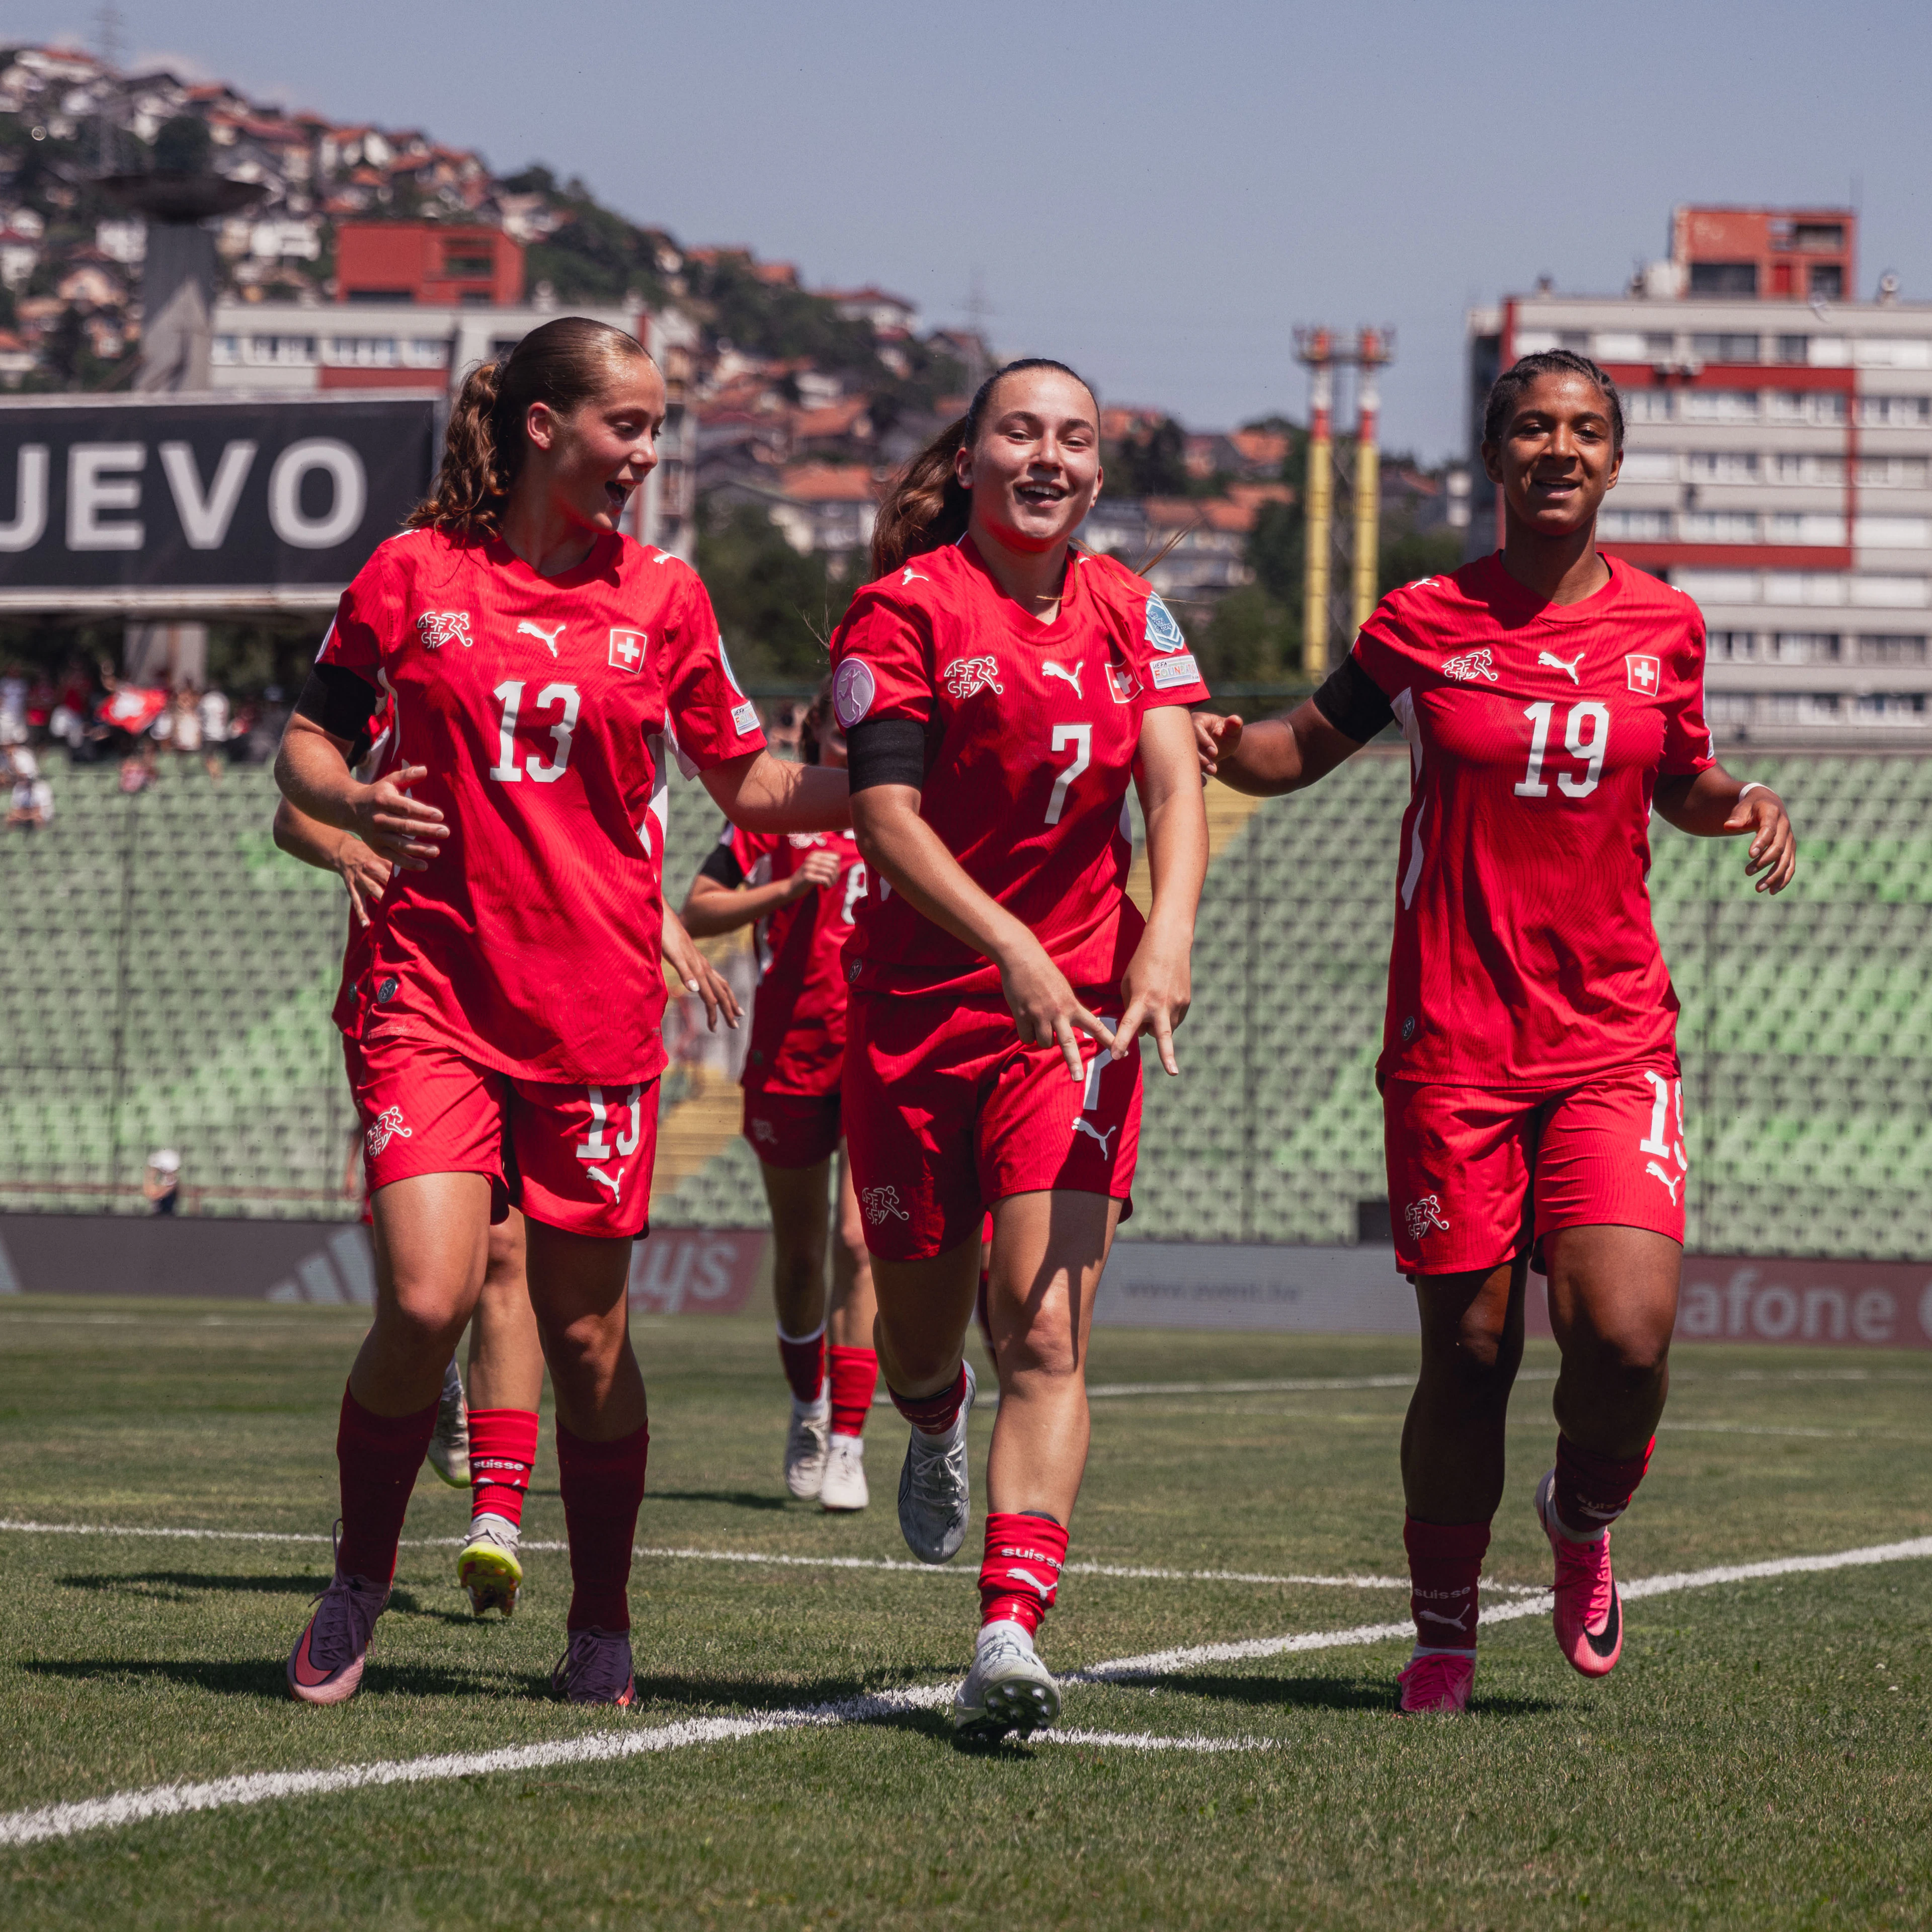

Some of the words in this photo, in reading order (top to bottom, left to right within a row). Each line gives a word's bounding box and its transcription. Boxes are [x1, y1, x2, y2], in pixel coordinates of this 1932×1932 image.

[0, 437, 367, 552] JEVO
[490, 680, 582, 783] 13
[734, 708, 745, 716] UEFA
[1514, 701, 1610, 798] 19
[1044, 725, 1093, 825] 7
[473, 1459, 524, 1471] suisse
[1414, 1586, 1471, 1599] suisse
